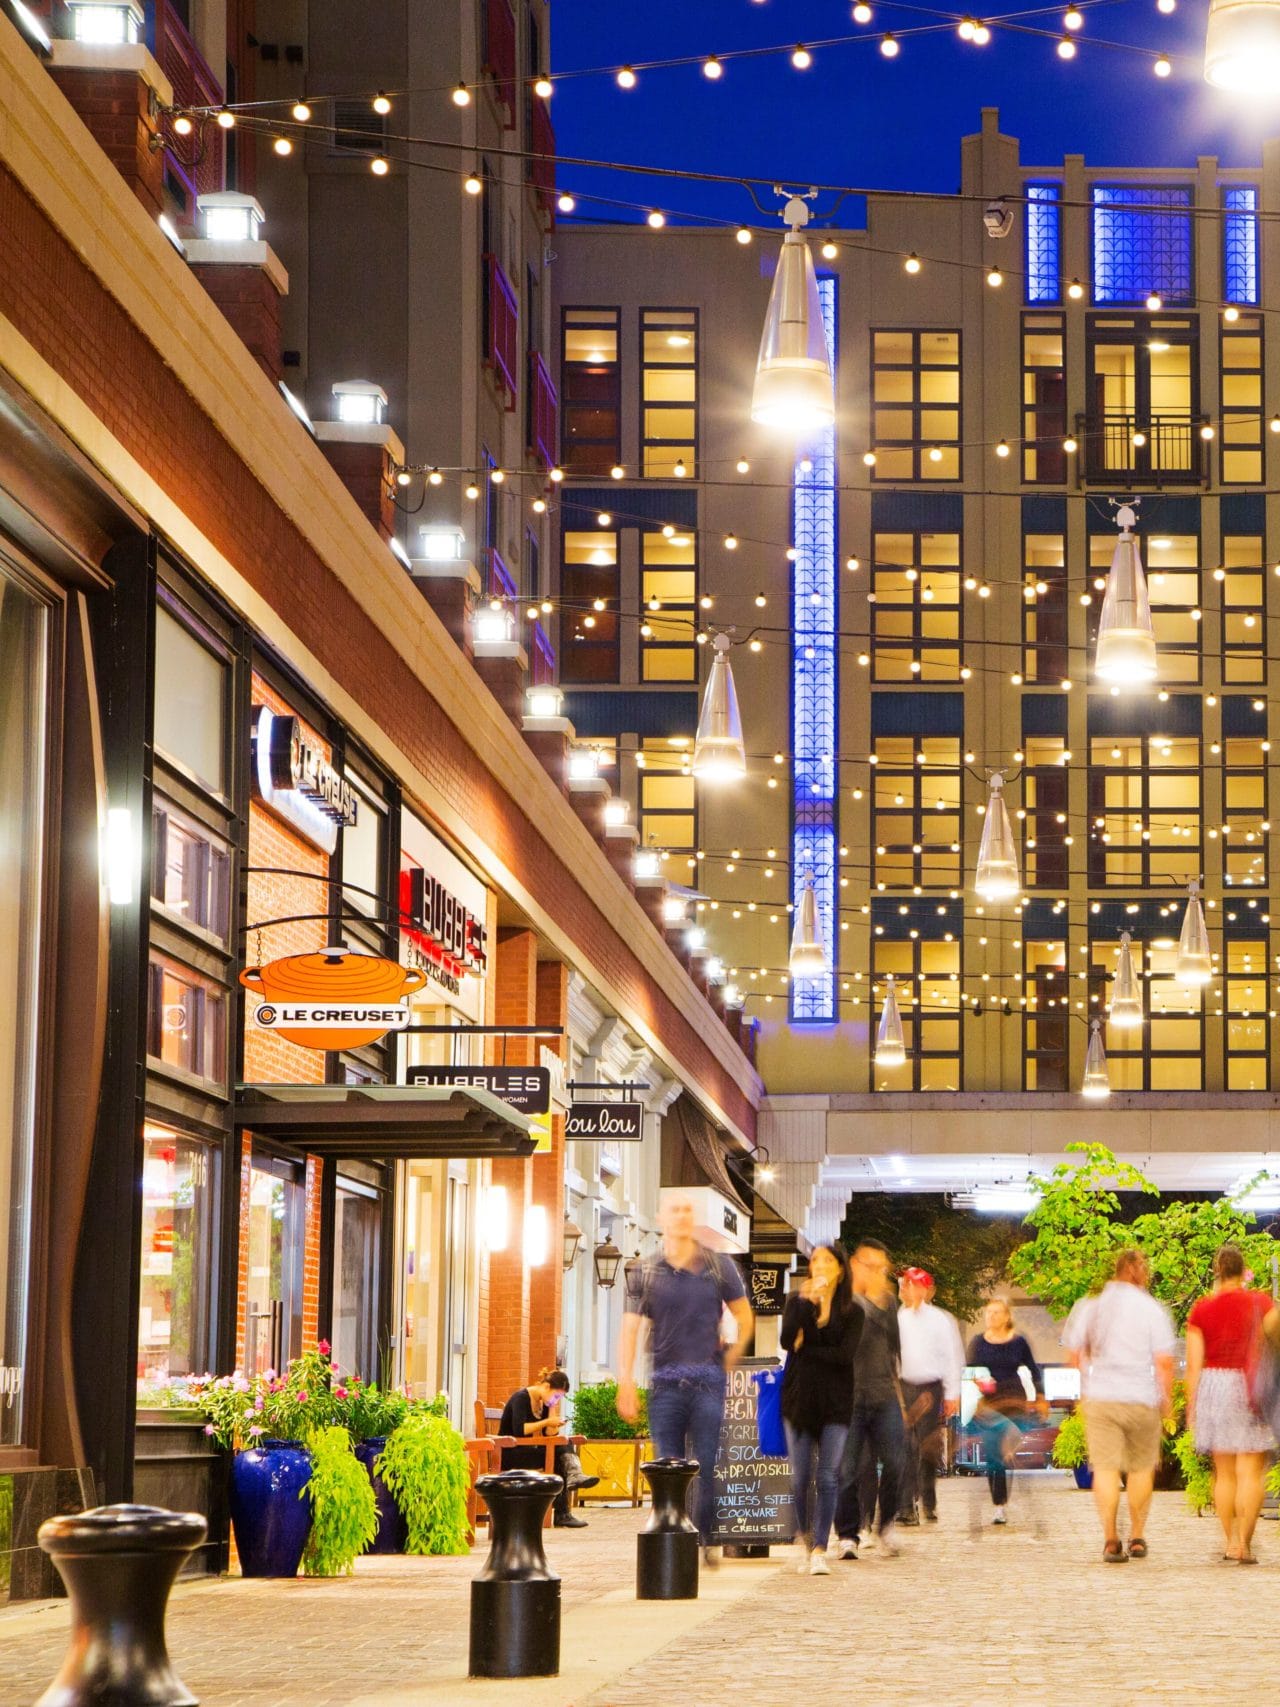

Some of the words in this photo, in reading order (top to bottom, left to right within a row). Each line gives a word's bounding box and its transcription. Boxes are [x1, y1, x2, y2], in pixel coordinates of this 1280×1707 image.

[282, 1009, 308, 1022] LE
[311, 1010, 407, 1023] CREUSET
[600, 1108, 636, 1134] lou
[726, 1479, 761, 1494] NEW!
[716, 1507, 779, 1519] COOKWARE
[731, 1524, 786, 1534] CREUSET
